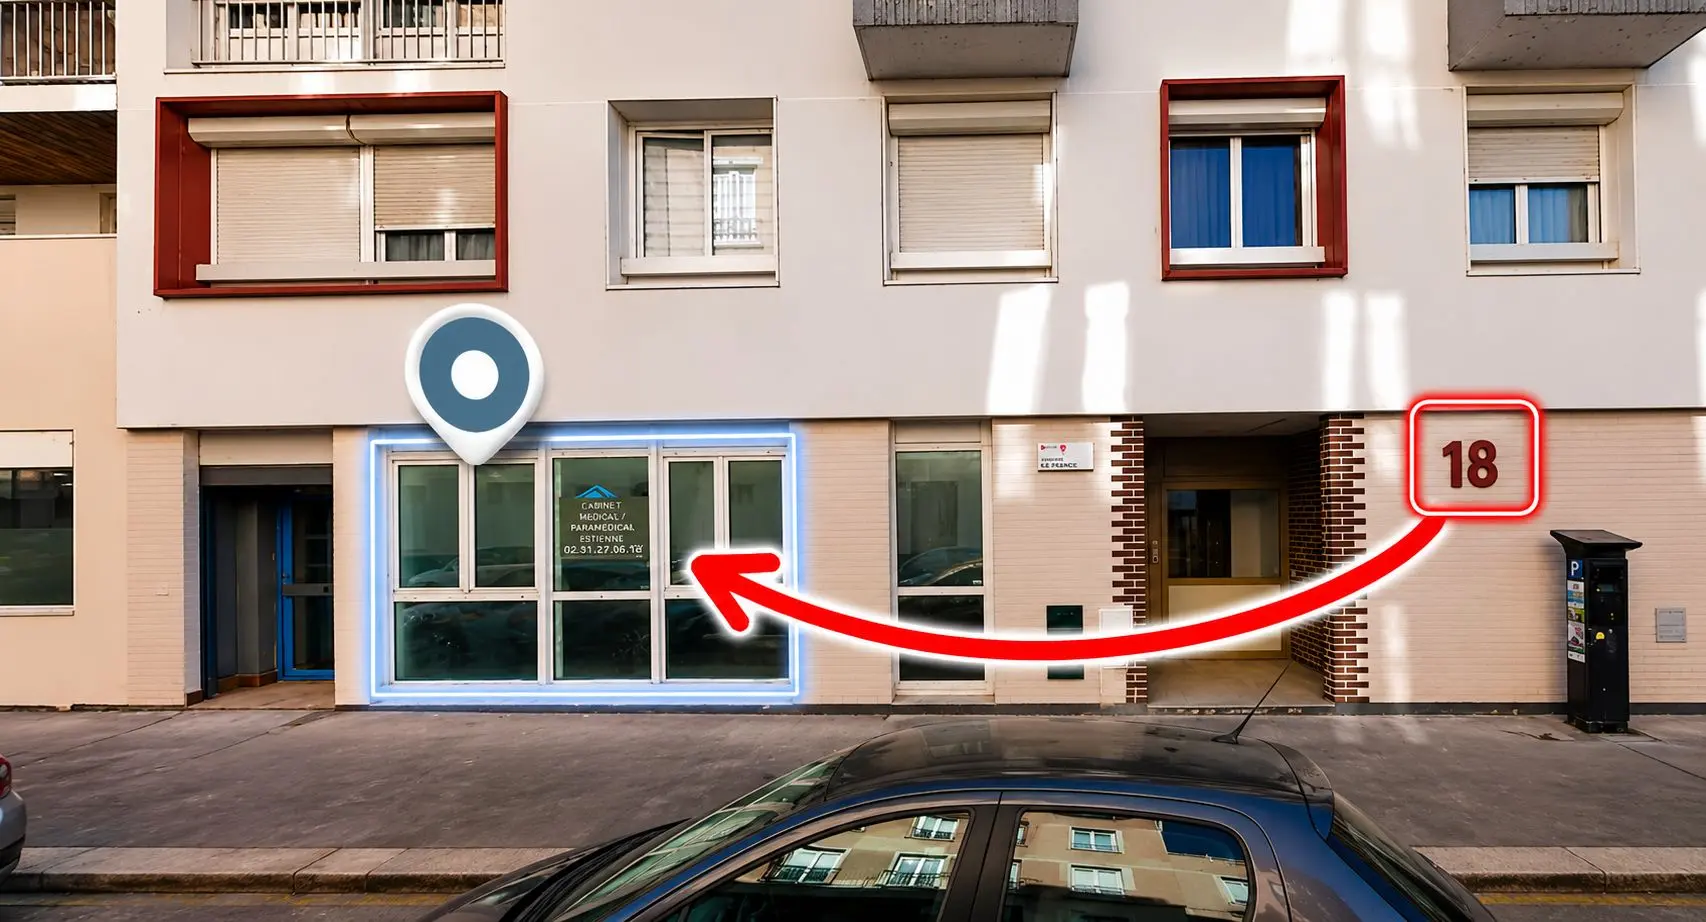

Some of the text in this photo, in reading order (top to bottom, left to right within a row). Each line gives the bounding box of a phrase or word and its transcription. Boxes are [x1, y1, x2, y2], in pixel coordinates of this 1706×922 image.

[1442, 440, 1499, 489] 18
[581, 502, 622, 510] CABINET
[579, 513, 619, 521] MEDICAL
[570, 524, 635, 532] PARAMEDICAL
[580, 535, 624, 543] ESTIENNE
[1571, 561, 1579, 576] P
